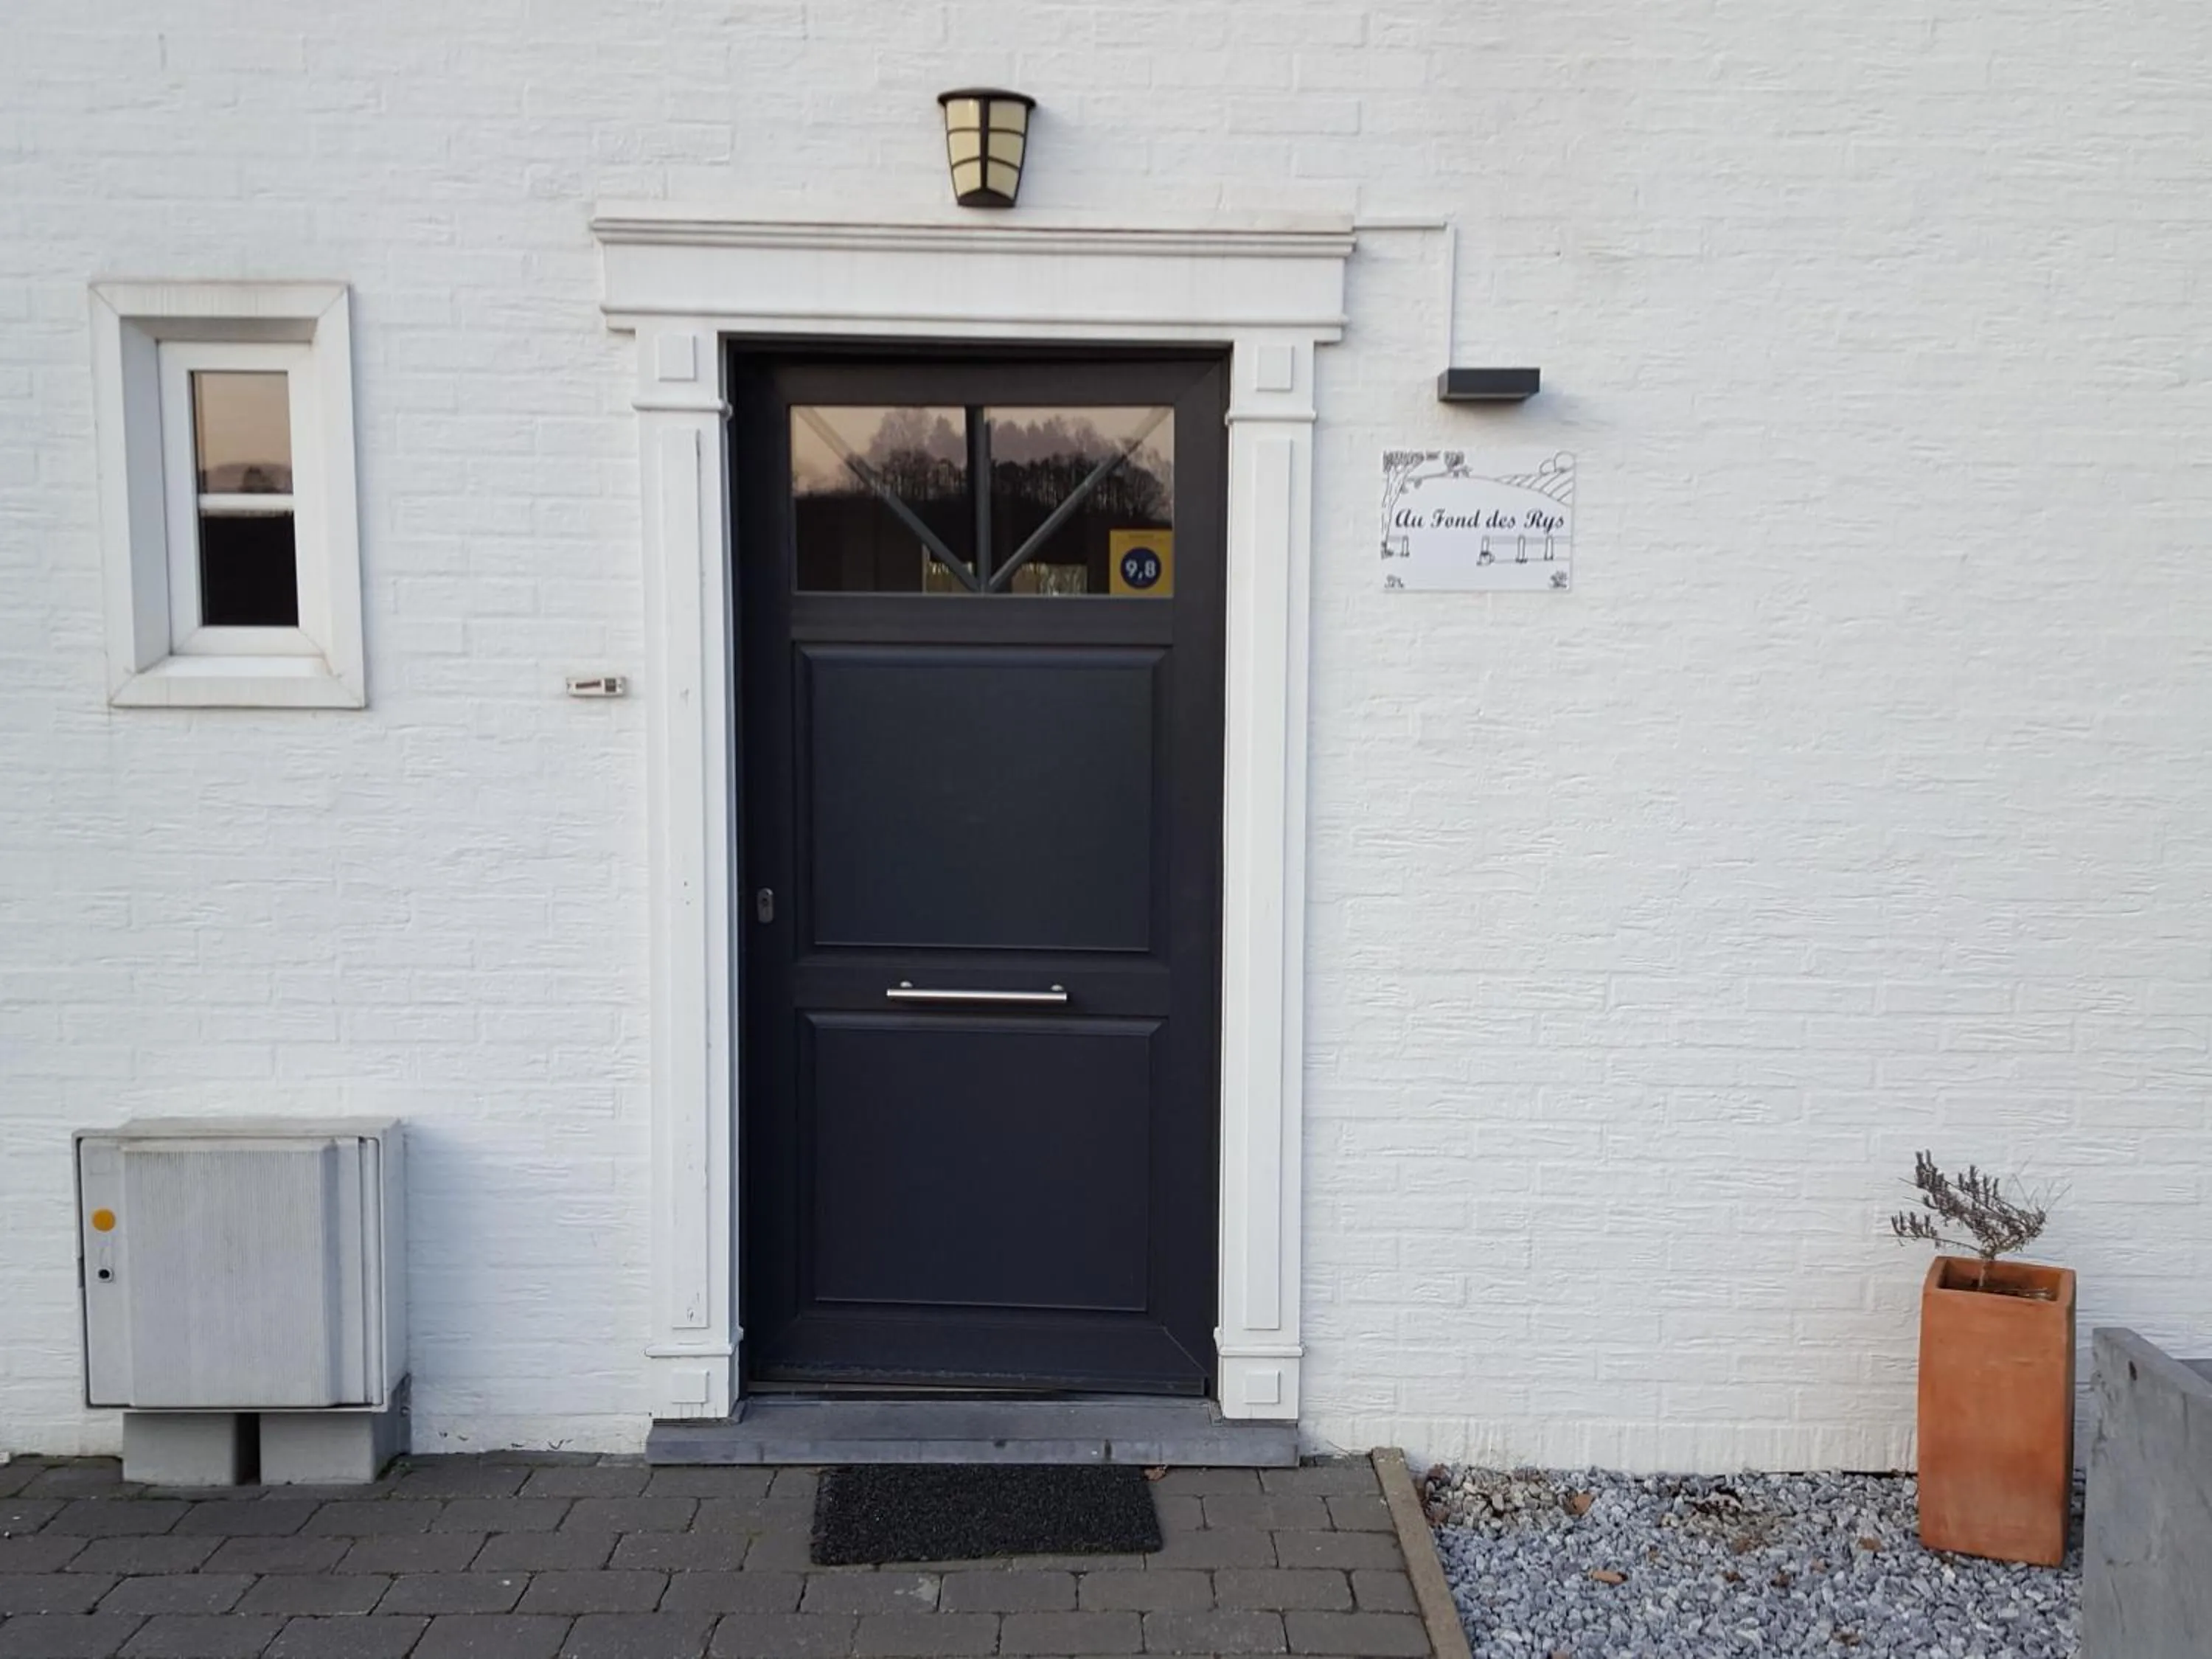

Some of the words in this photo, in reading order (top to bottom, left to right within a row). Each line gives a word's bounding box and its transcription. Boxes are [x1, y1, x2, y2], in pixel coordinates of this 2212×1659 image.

[1395, 508, 1424, 529] Au
[1430, 508, 1481, 529] Fond
[1486, 509, 1516, 529] des
[1524, 509, 1565, 535] Rys
[1126, 559, 1157, 580] 9,8
